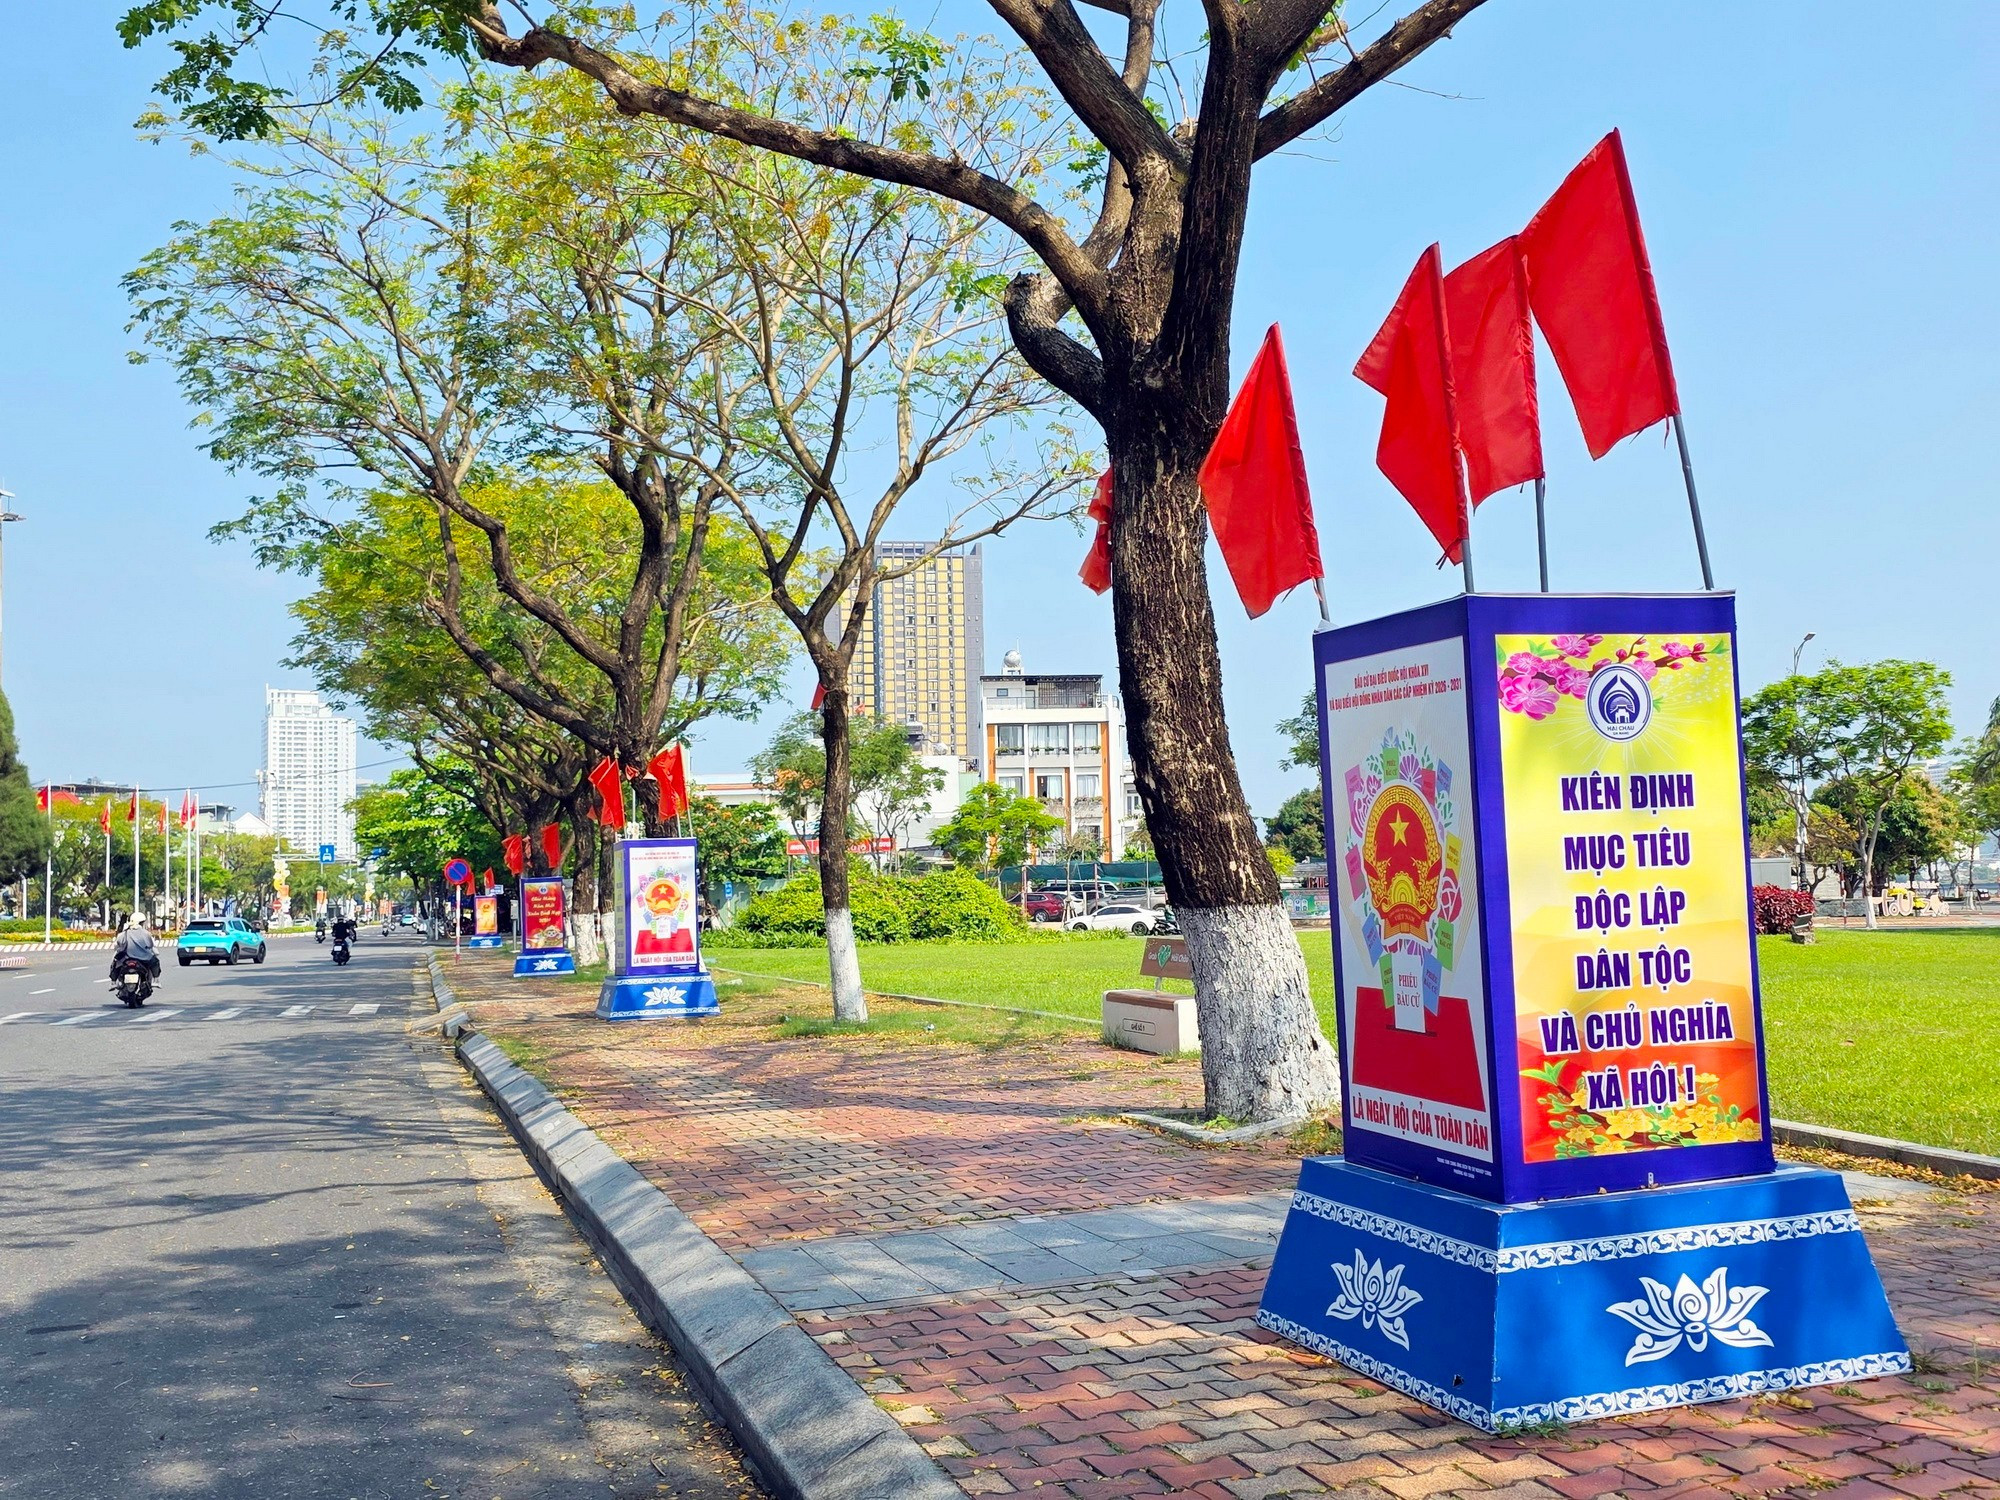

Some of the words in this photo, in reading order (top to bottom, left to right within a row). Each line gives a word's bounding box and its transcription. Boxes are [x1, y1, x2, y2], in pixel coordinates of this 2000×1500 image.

[1435, 680, 1446, 694] 2026
[1450, 678, 1462, 691] 2031
[1561, 770, 1622, 811] KIÊN
[1630, 774, 1694, 814] ĐỊNH
[1564, 834, 1625, 876] MỤC
[1633, 826, 1690, 867] TIÊU
[1576, 888, 1631, 934] ĐỘC
[1640, 886, 1686, 932] LẬP
[1399, 972, 1417, 988] PHIẾU
[1576, 948, 1630, 990] DÂN
[1638, 944, 1691, 990] TỘC
[1397, 990, 1409, 1006] BẦU
[1410, 992, 1420, 1008] CỬ
[1541, 1012, 1578, 1052] VÀ
[1586, 1003, 1642, 1050] CHỦ
[1650, 1001, 1732, 1044] NGHĨA
[1588, 1068, 1623, 1110] XÃ
[1630, 1064, 1677, 1110] HỘI
[1686, 1067, 1694, 1100] !
[1352, 1092, 1365, 1120] LÀ
[1366, 1096, 1390, 1126] NGÀY
[1393, 1102, 1410, 1136] HỘI
[1412, 1101, 1433, 1137] CỦA
[1434, 1112, 1463, 1145] TOÀN
[1465, 1118, 1489, 1151] DÂN
